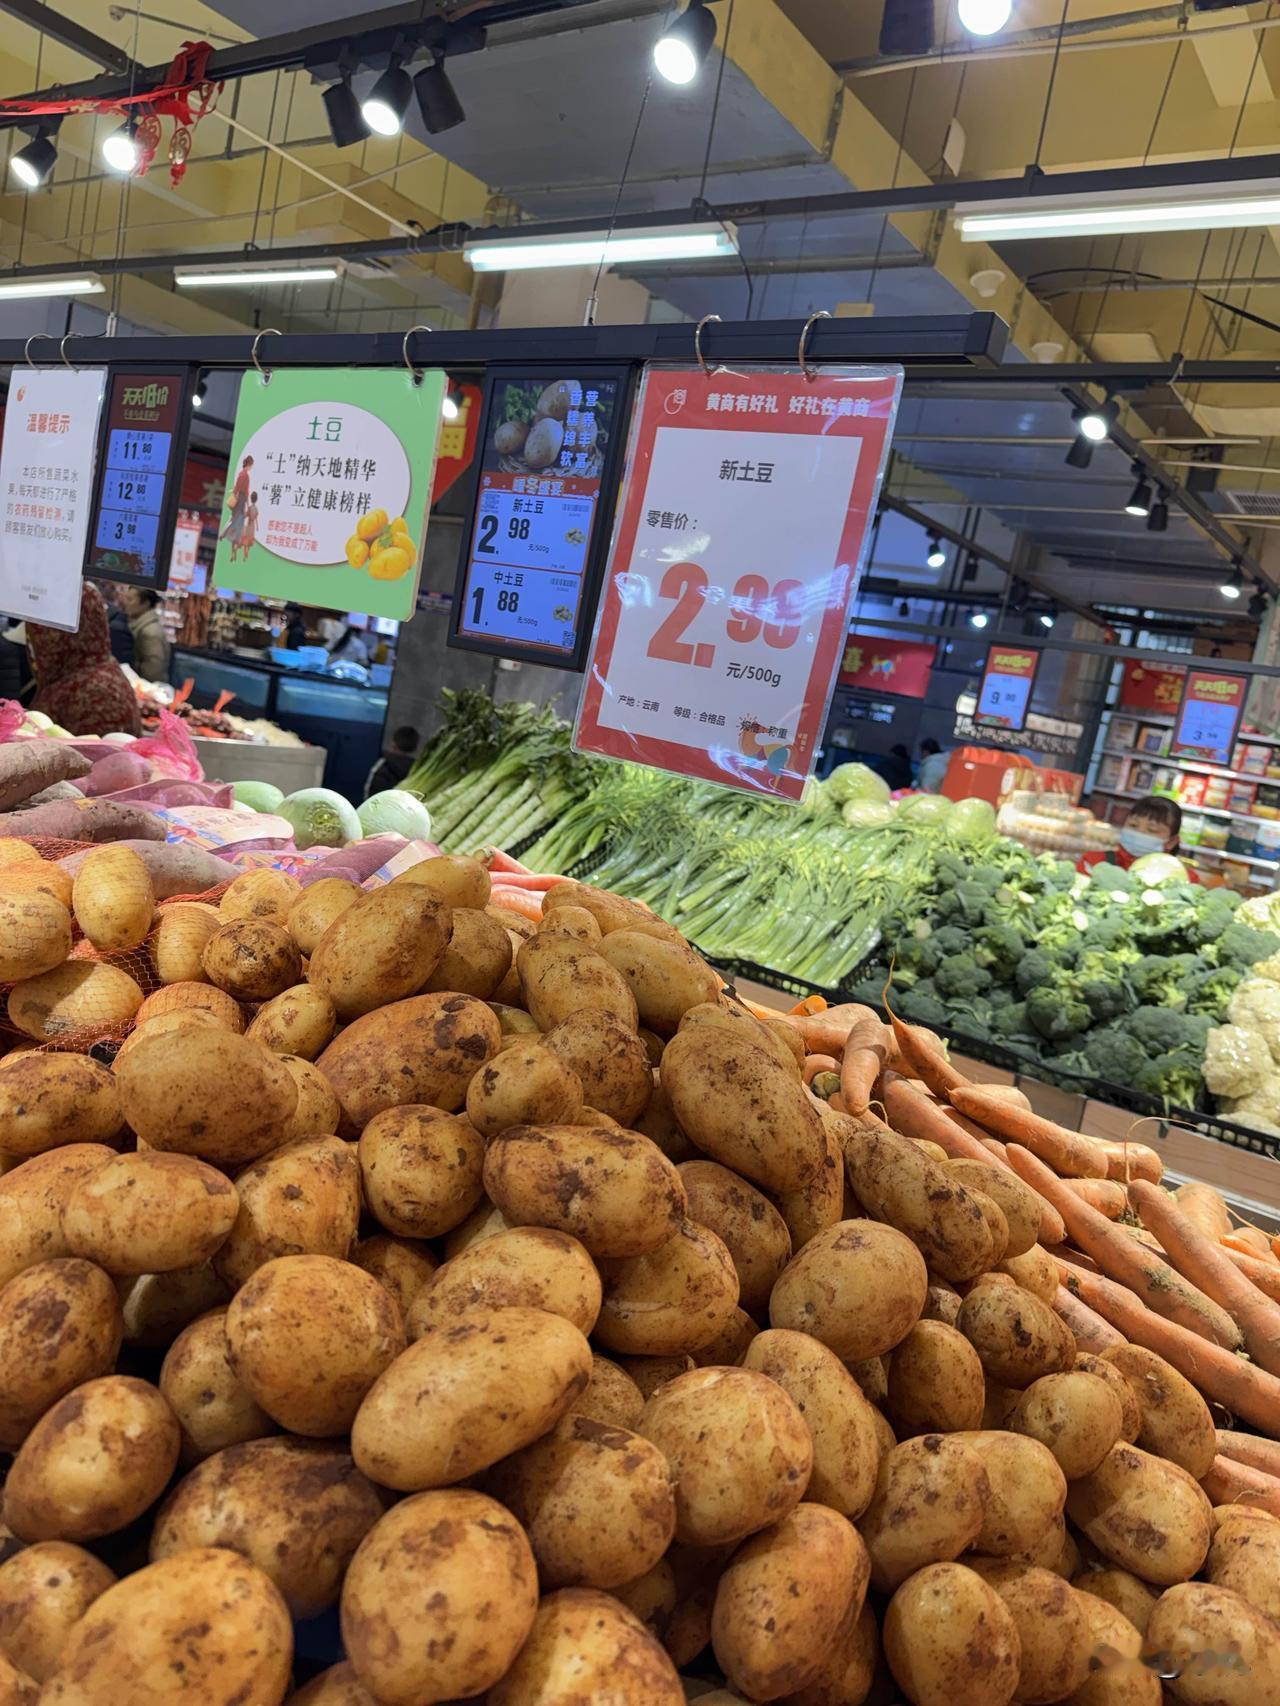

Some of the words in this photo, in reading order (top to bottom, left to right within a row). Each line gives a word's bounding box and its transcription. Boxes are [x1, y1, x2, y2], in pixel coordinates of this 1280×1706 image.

[705, 393, 780, 414] 黄商有好礼
[788, 396, 871, 417] 好礼在黄商
[26, 413, 71, 434] 温馨提示
[306, 415, 344, 443] 土豆
[265, 452, 377, 482] “土”纳天地精华
[719, 460, 774, 484] 新土豆
[511, 498, 545, 514] 新土豆
[493, 572, 525, 588] 中土豆
[725, 661, 781, 688] 元/500g
[617, 693, 660, 713] 产地：云南
[673, 705, 726, 727] 等级：合格品
